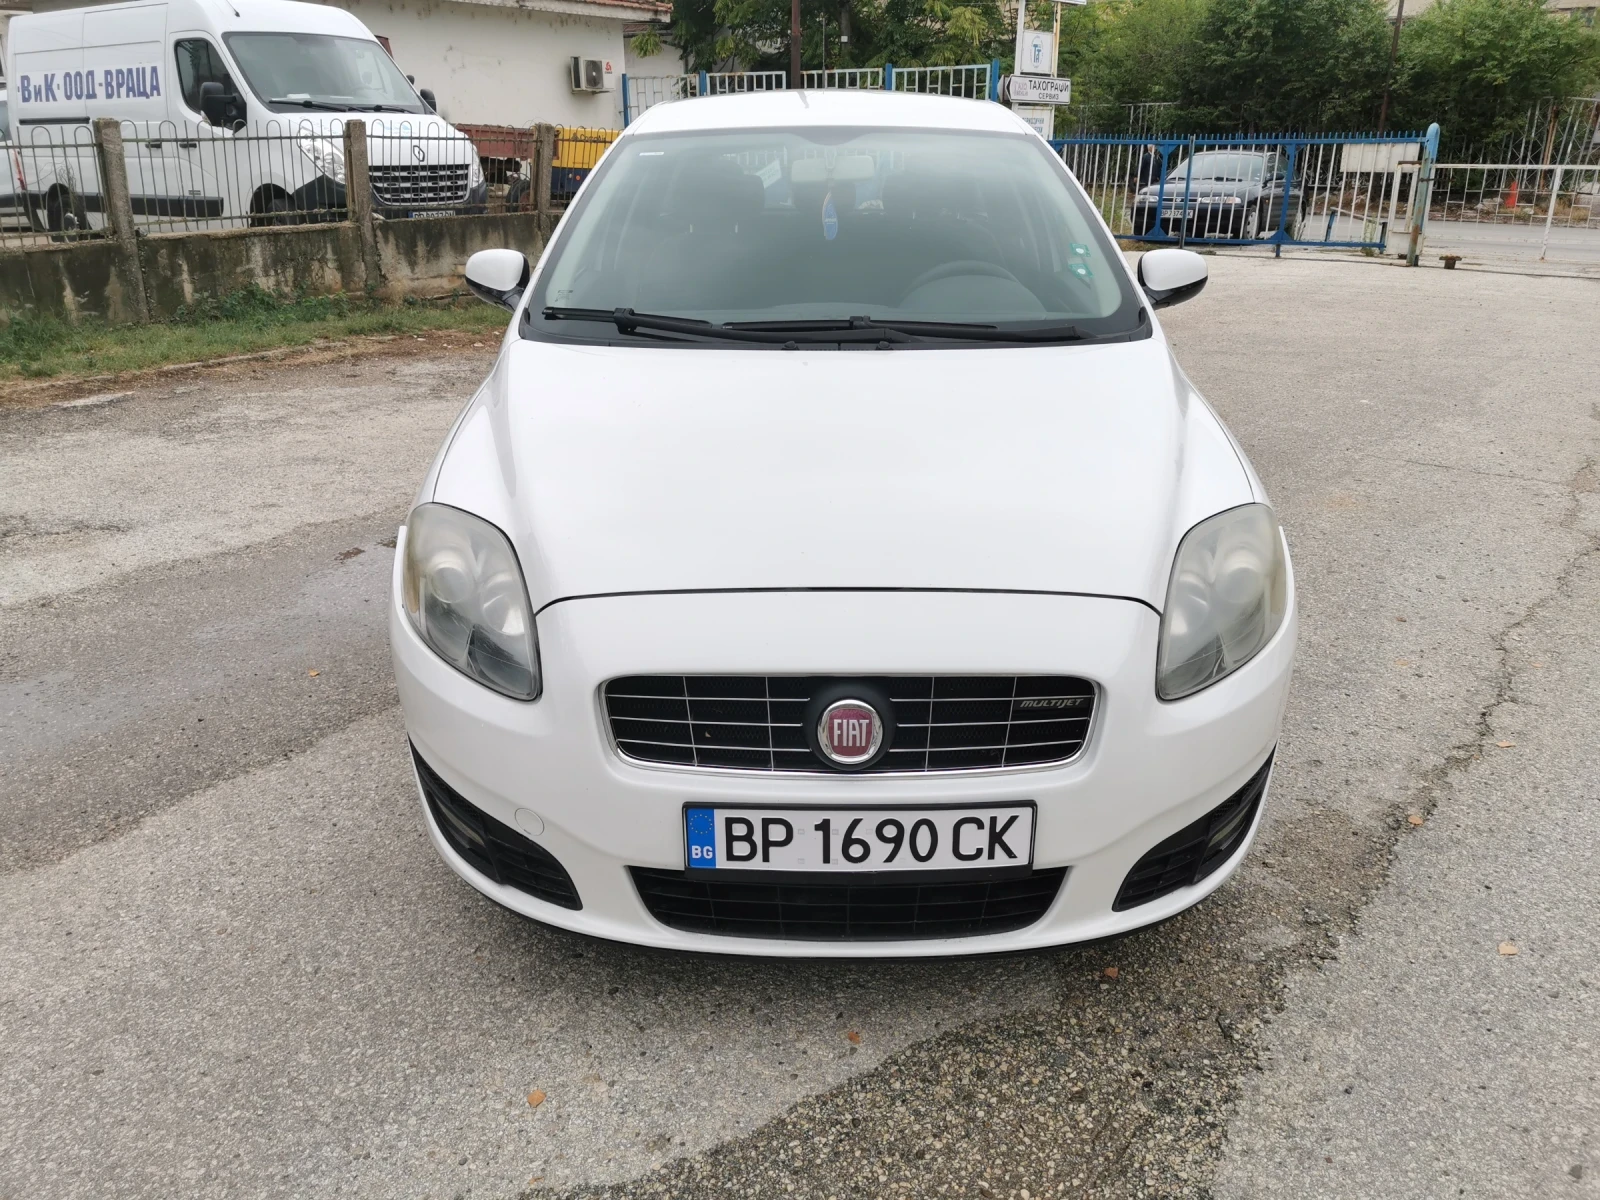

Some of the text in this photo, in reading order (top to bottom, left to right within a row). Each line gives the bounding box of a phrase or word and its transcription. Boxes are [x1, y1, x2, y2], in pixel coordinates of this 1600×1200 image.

[104, 66, 161, 100] ВРАЦА
[1038, 92, 1059, 100] СЕРВИЗ
[1020, 698, 1084, 709] MULTIJET
[833, 718, 870, 747] FIAT
[724, 814, 1020, 864] BP 1690 CK
[691, 845, 713, 859] BG
